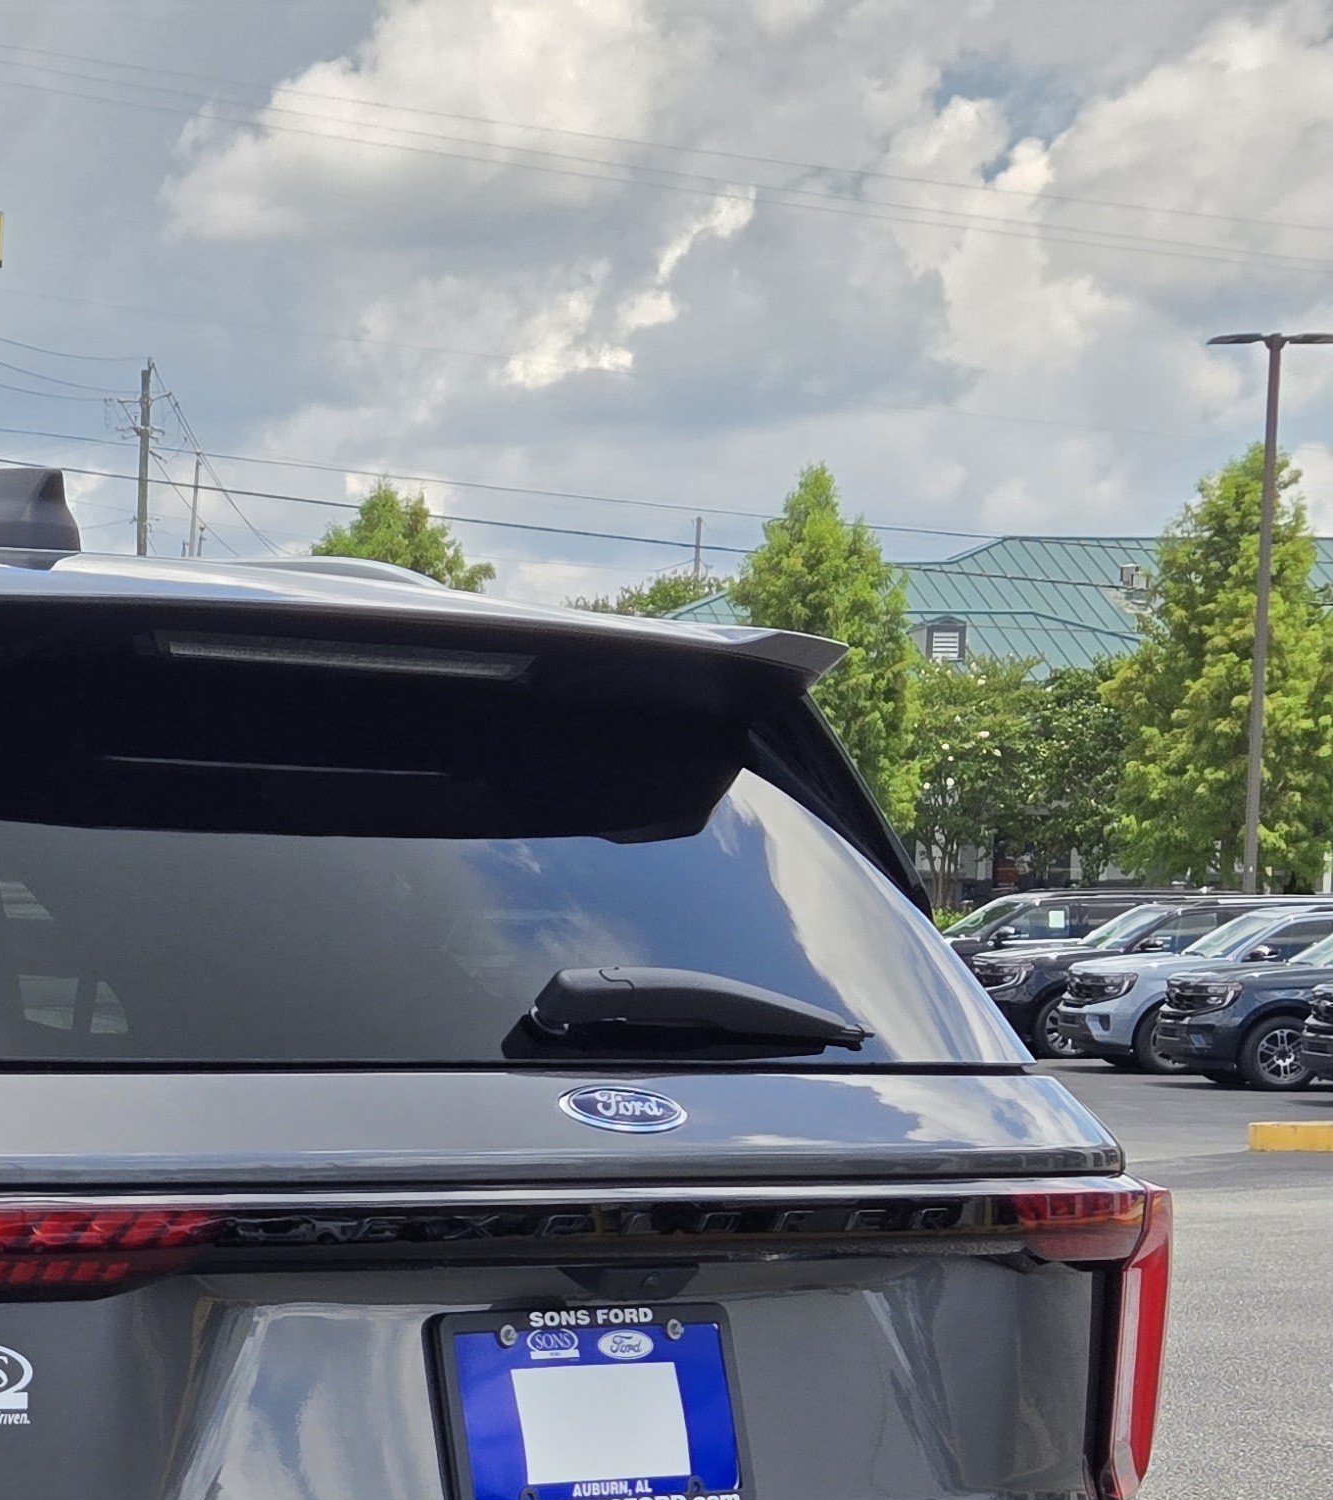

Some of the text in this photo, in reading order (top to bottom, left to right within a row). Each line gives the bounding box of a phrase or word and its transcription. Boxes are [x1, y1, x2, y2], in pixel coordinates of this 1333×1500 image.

[594, 1089, 665, 1117] Ford
[529, 1306, 654, 1328] SONS FORD
[533, 1331, 572, 1350] SONS
[609, 1334, 643, 1355] Ford
[571, 1478, 653, 1498] AUBURN, AL
